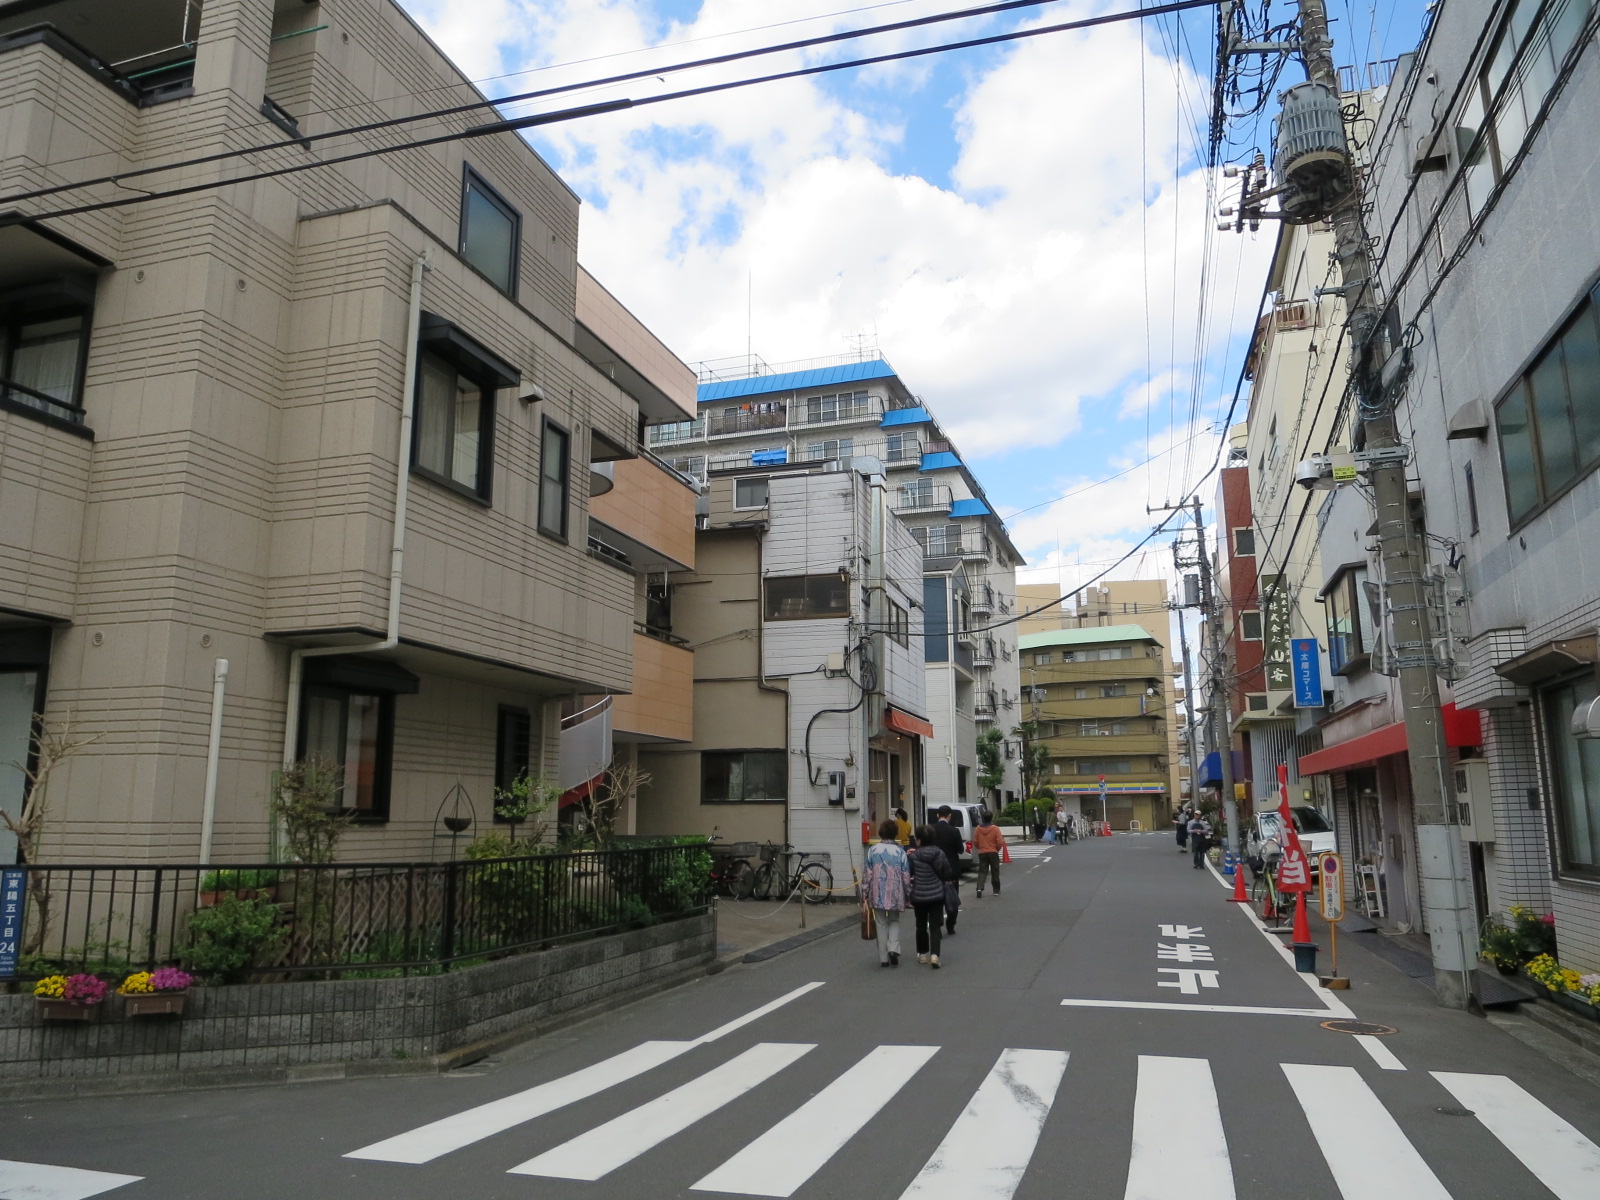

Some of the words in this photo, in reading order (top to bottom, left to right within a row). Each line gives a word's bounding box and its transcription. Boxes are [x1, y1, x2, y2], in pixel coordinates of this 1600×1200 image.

[1301, 653, 1312, 700] 太陽コマース
[4, 879, 19, 937] 東陽五丁目
[0, 942, 15, 953] 24
